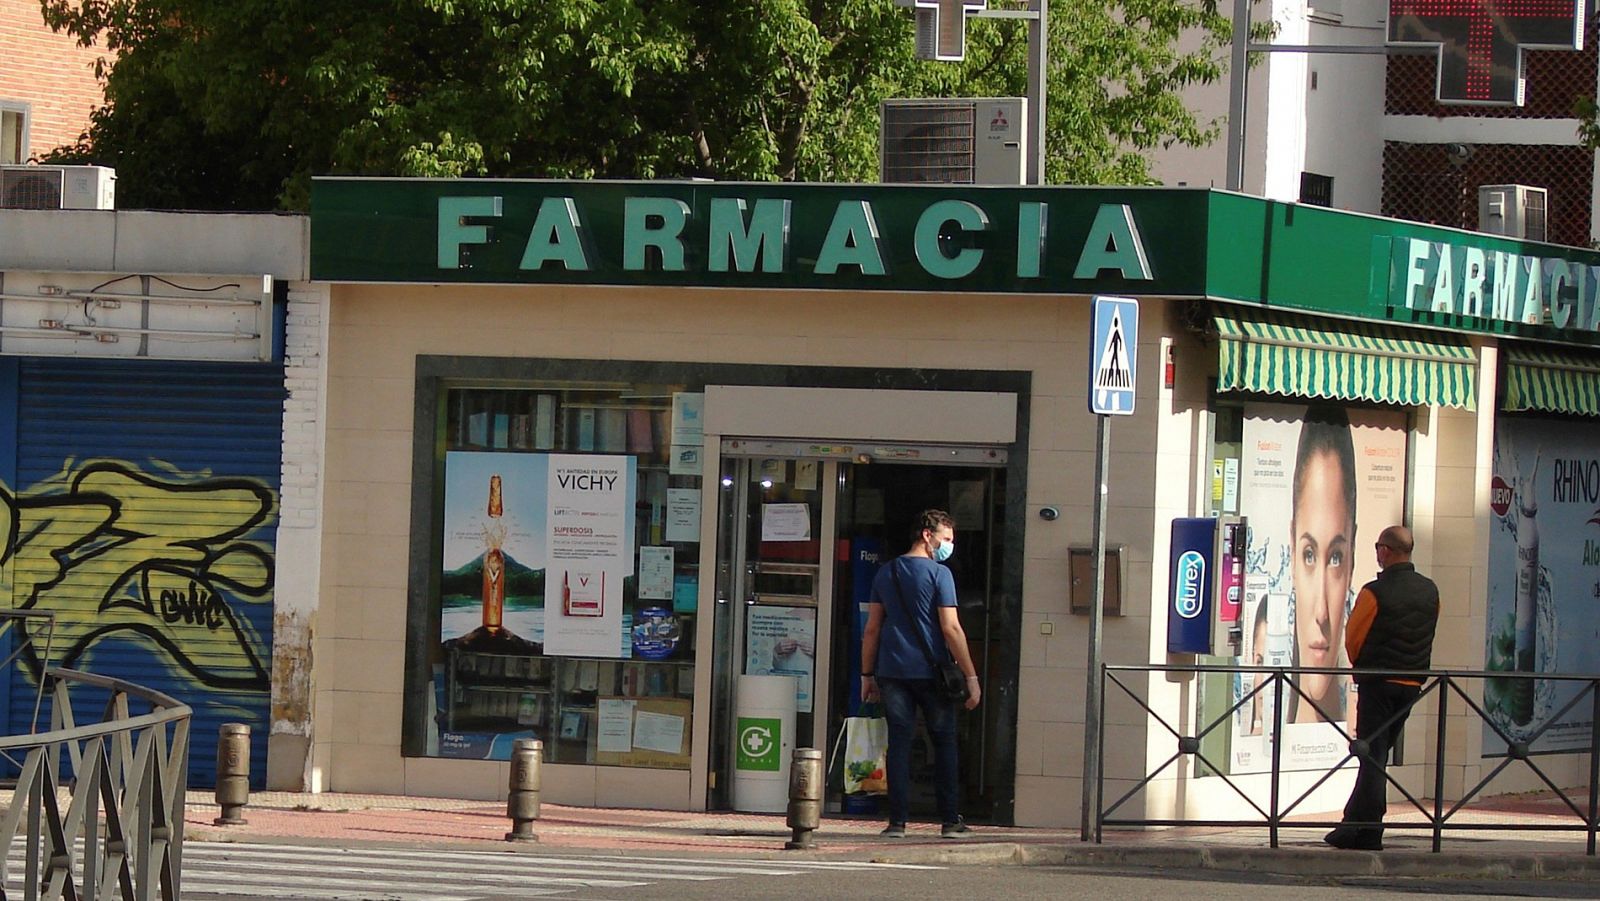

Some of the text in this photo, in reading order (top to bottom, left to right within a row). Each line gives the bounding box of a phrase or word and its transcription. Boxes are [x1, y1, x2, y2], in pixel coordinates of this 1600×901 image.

[437, 196, 1154, 281] FARMACIA
[557, 474, 618, 491] VICHY
[1180, 556, 1202, 612] durex
